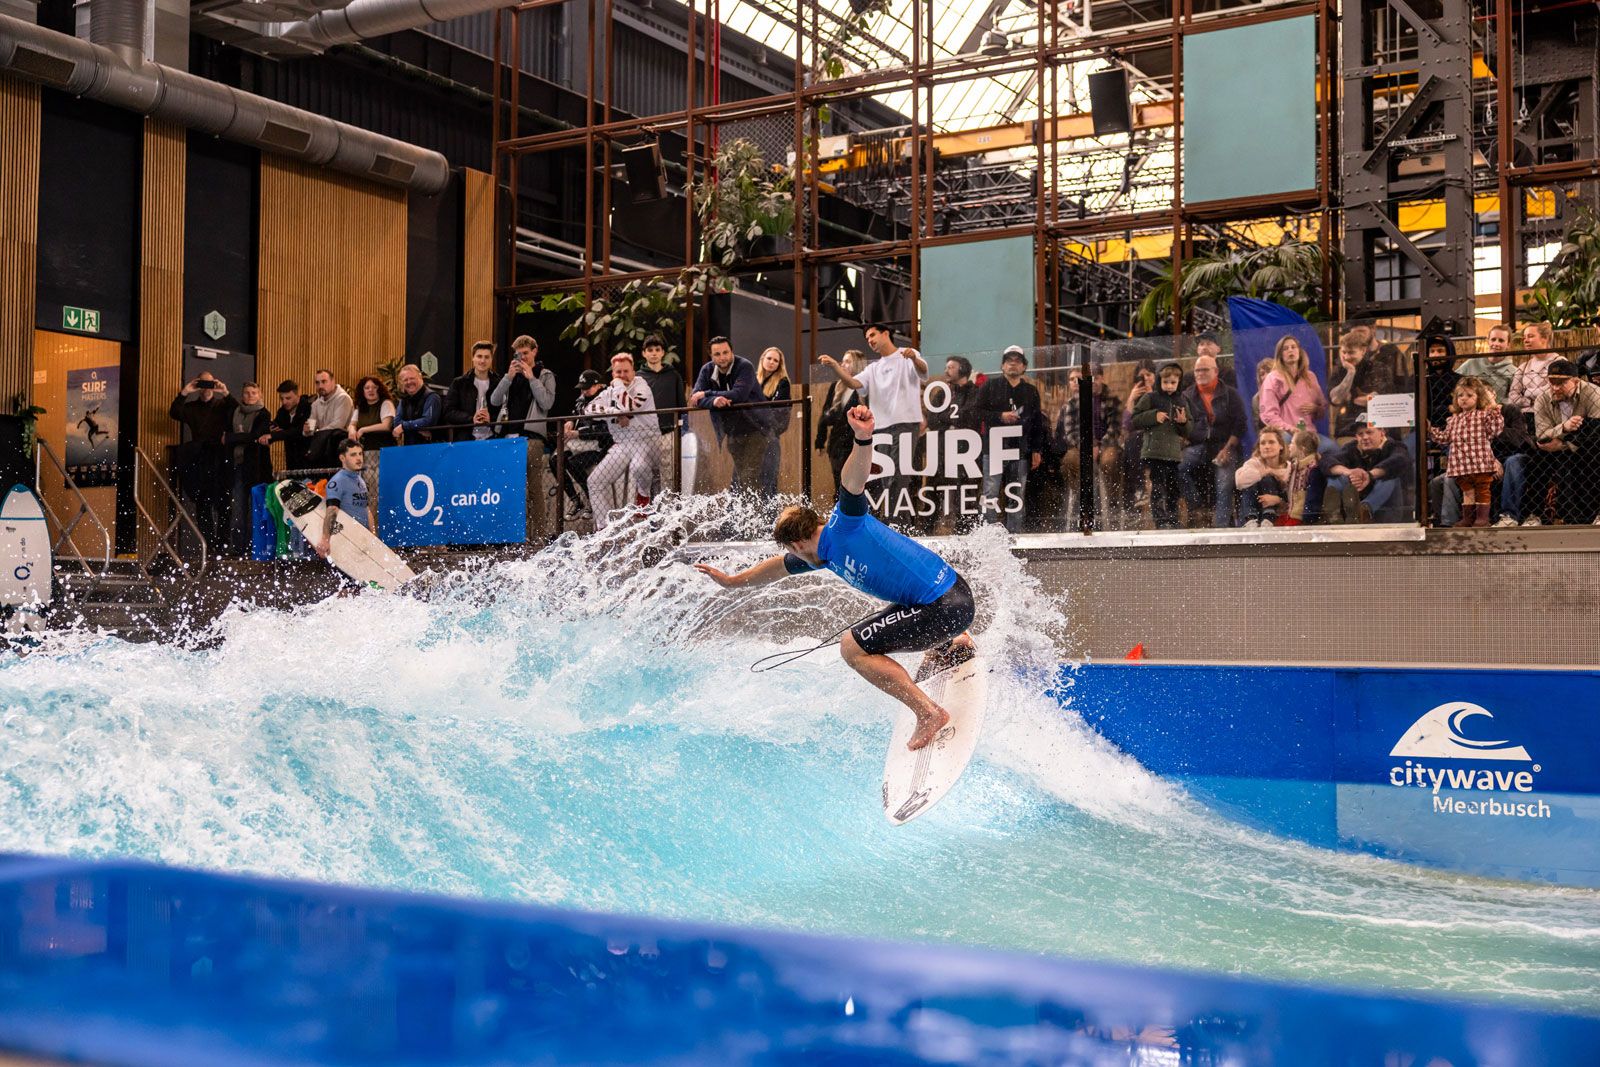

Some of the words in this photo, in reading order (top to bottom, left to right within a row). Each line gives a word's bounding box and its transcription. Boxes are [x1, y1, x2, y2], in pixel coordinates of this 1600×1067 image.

[82, 381, 107, 393] SURF
[924, 381, 959, 419] O2
[867, 425, 1023, 481] SURF
[404, 474, 443, 525] O2
[451, 493, 477, 506] can
[481, 488, 500, 505] do
[864, 482, 1023, 517] MASTERS
[14, 562, 33, 580] O2
[860, 607, 922, 641] O'NEILL
[1432, 796, 1551, 818] Meerbusch
